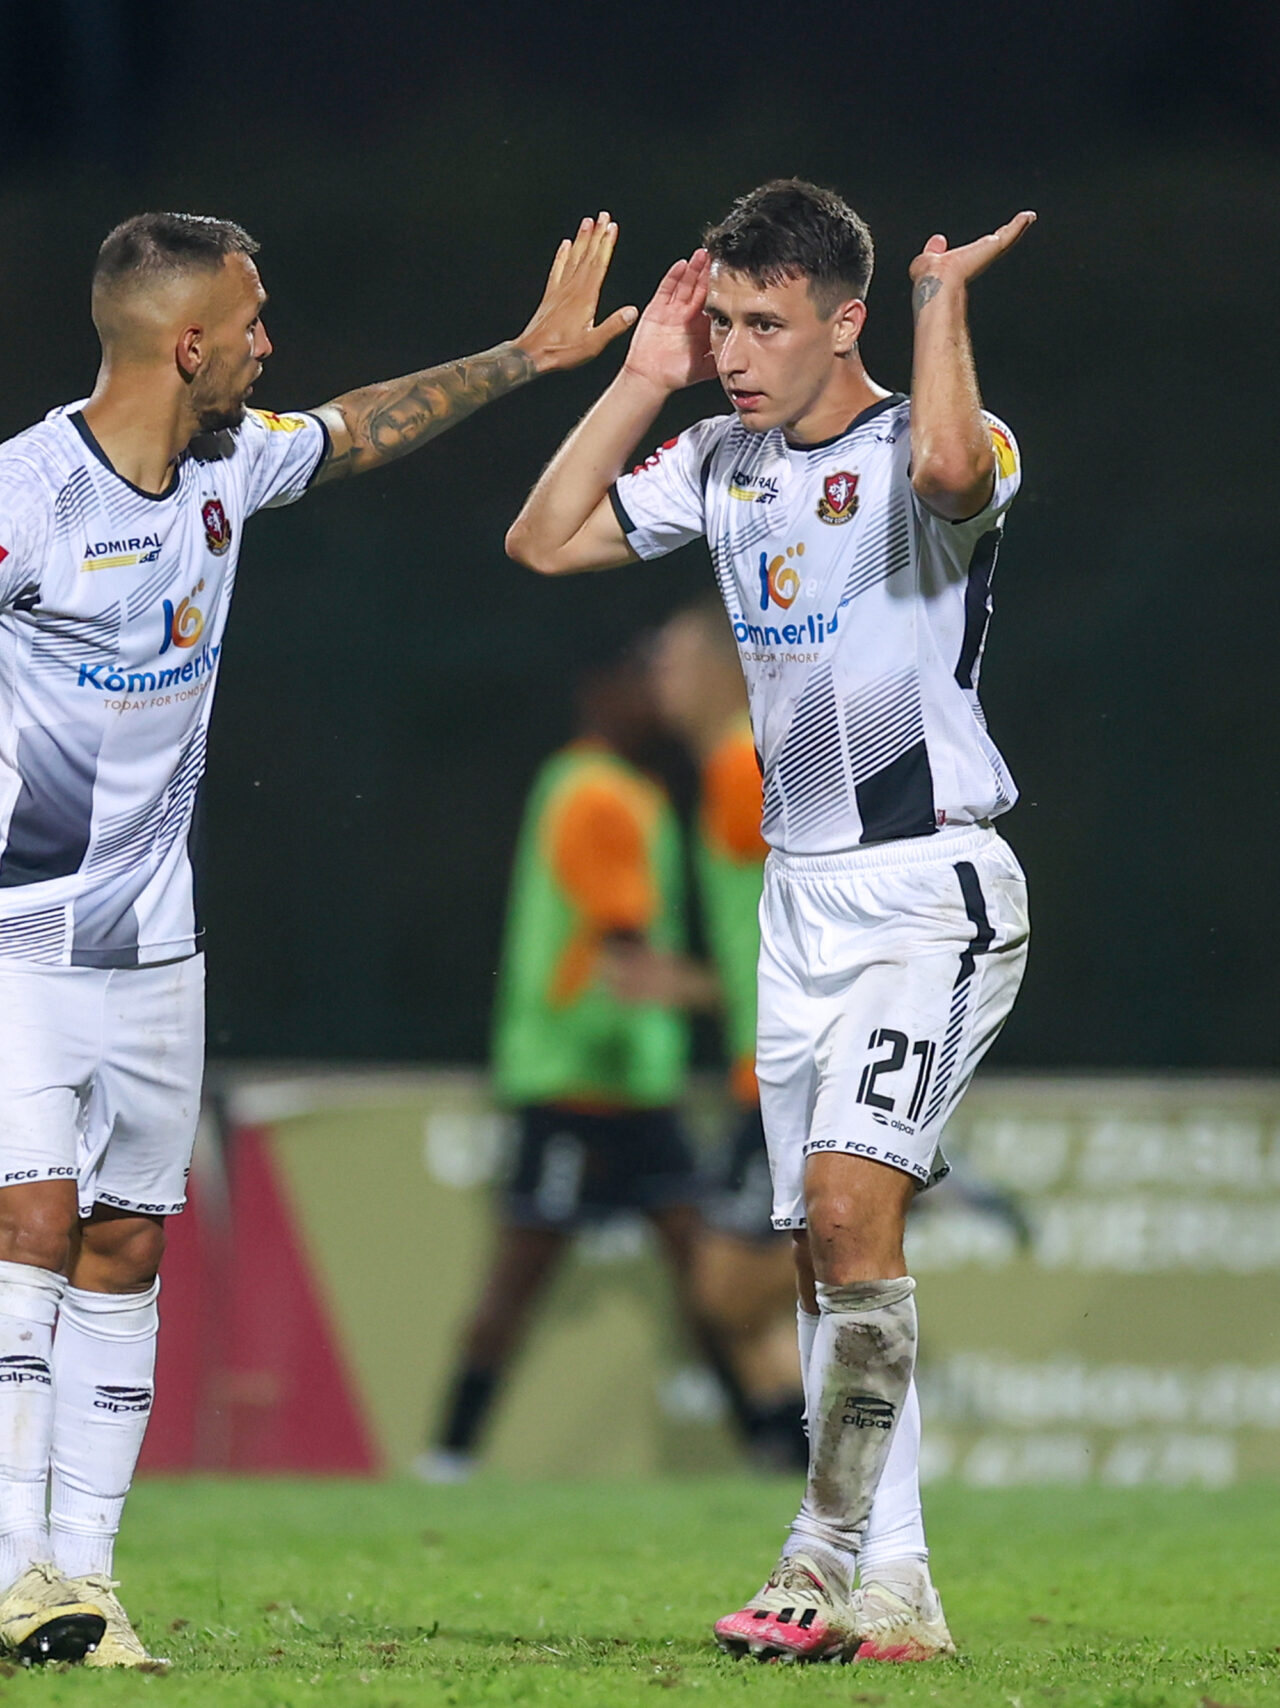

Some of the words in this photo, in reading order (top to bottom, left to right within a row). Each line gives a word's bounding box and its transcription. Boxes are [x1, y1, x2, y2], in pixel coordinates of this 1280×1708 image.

[84, 532, 163, 559] ADMIRAL
[104, 698, 147, 711] TODAY
[150, 696, 171, 707] FOR
[855, 1028, 936, 1123] 21
[890, 1119, 915, 1136] alpas
[811, 1139, 837, 1150] FCG
[845, 1141, 878, 1156] FCG
[884, 1151, 909, 1167] FCG
[5, 1169, 39, 1182] FCG
[47, 1166, 73, 1176] FCG
[99, 1193, 130, 1206] FCG
[136, 1203, 166, 1212] FCG
